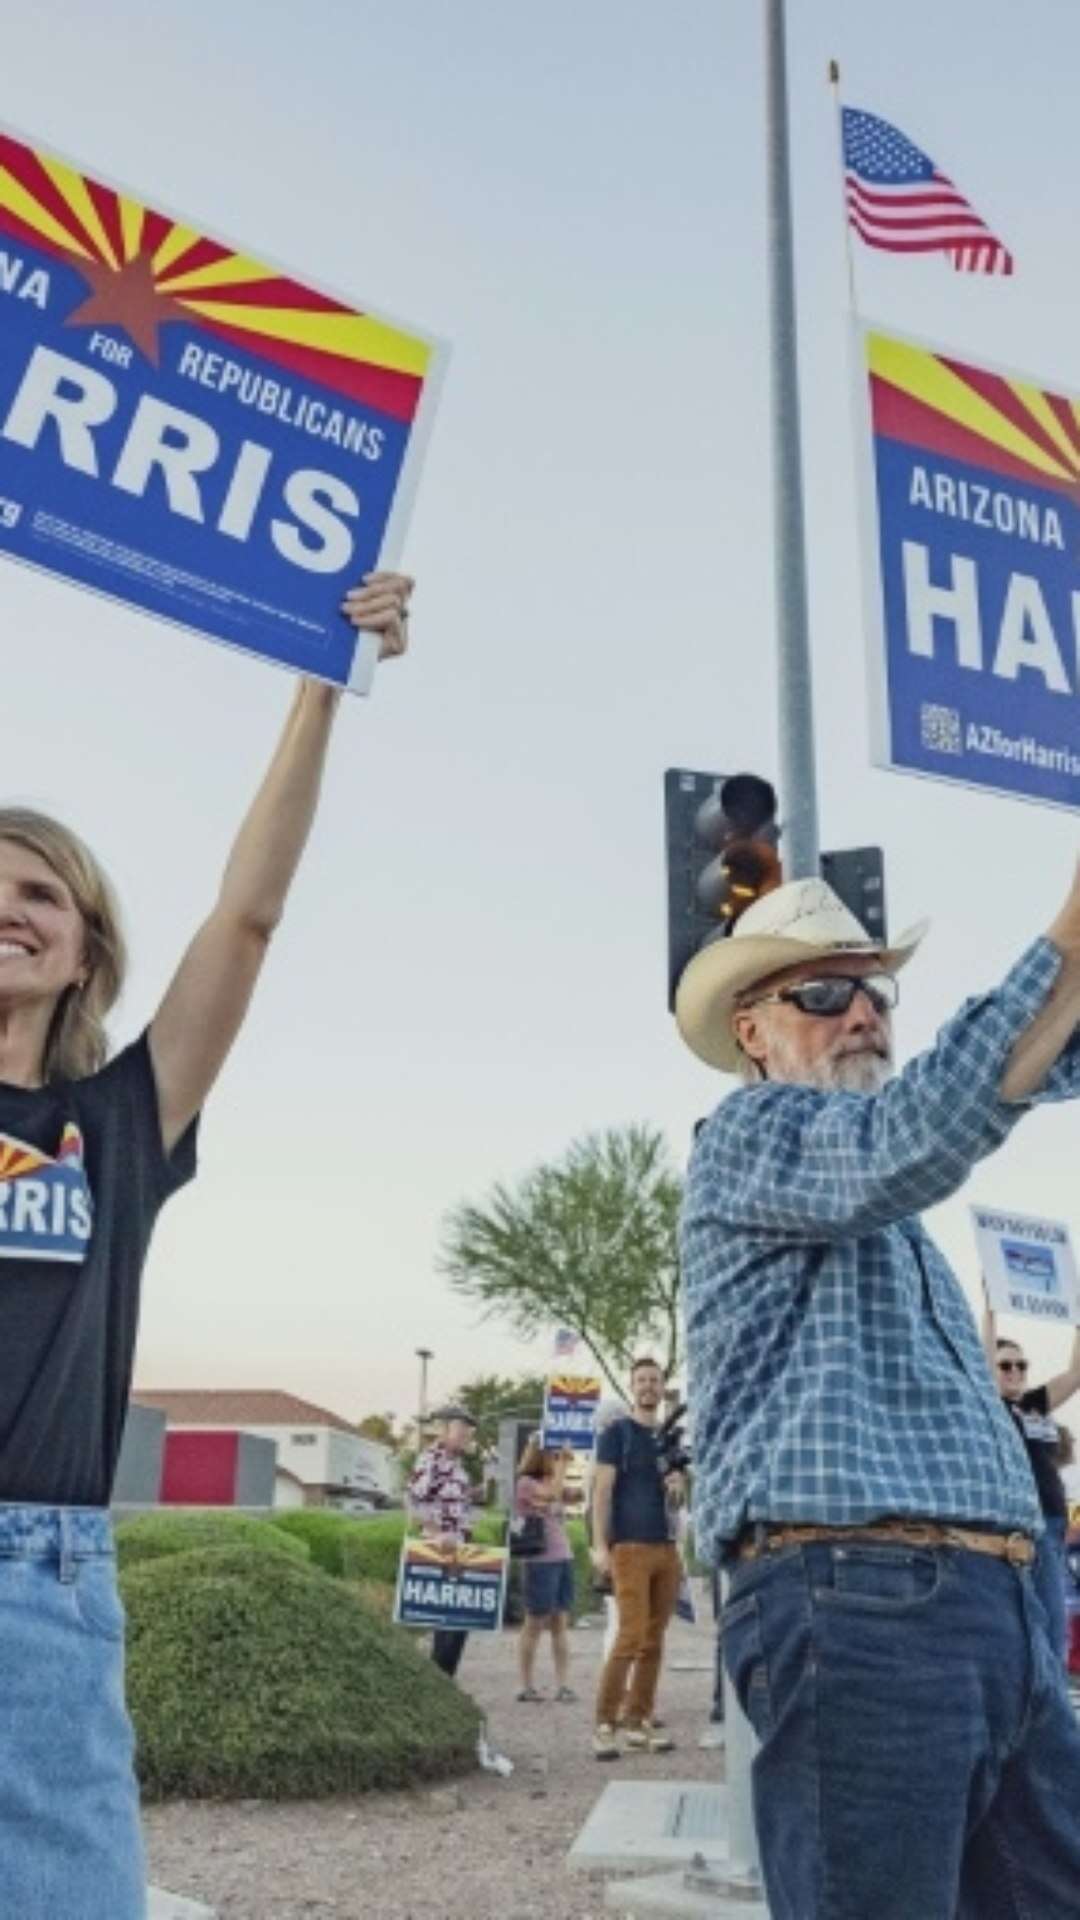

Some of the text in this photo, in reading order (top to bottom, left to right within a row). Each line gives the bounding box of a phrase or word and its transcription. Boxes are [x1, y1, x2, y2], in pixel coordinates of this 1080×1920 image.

[90, 330, 133, 370] FOR
[178, 342, 386, 462] REPUBLICANS
[2, 345, 361, 575] RRIS
[909, 466, 1065, 550] ARIZONA
[404, 1578, 497, 1612] HARRIS
